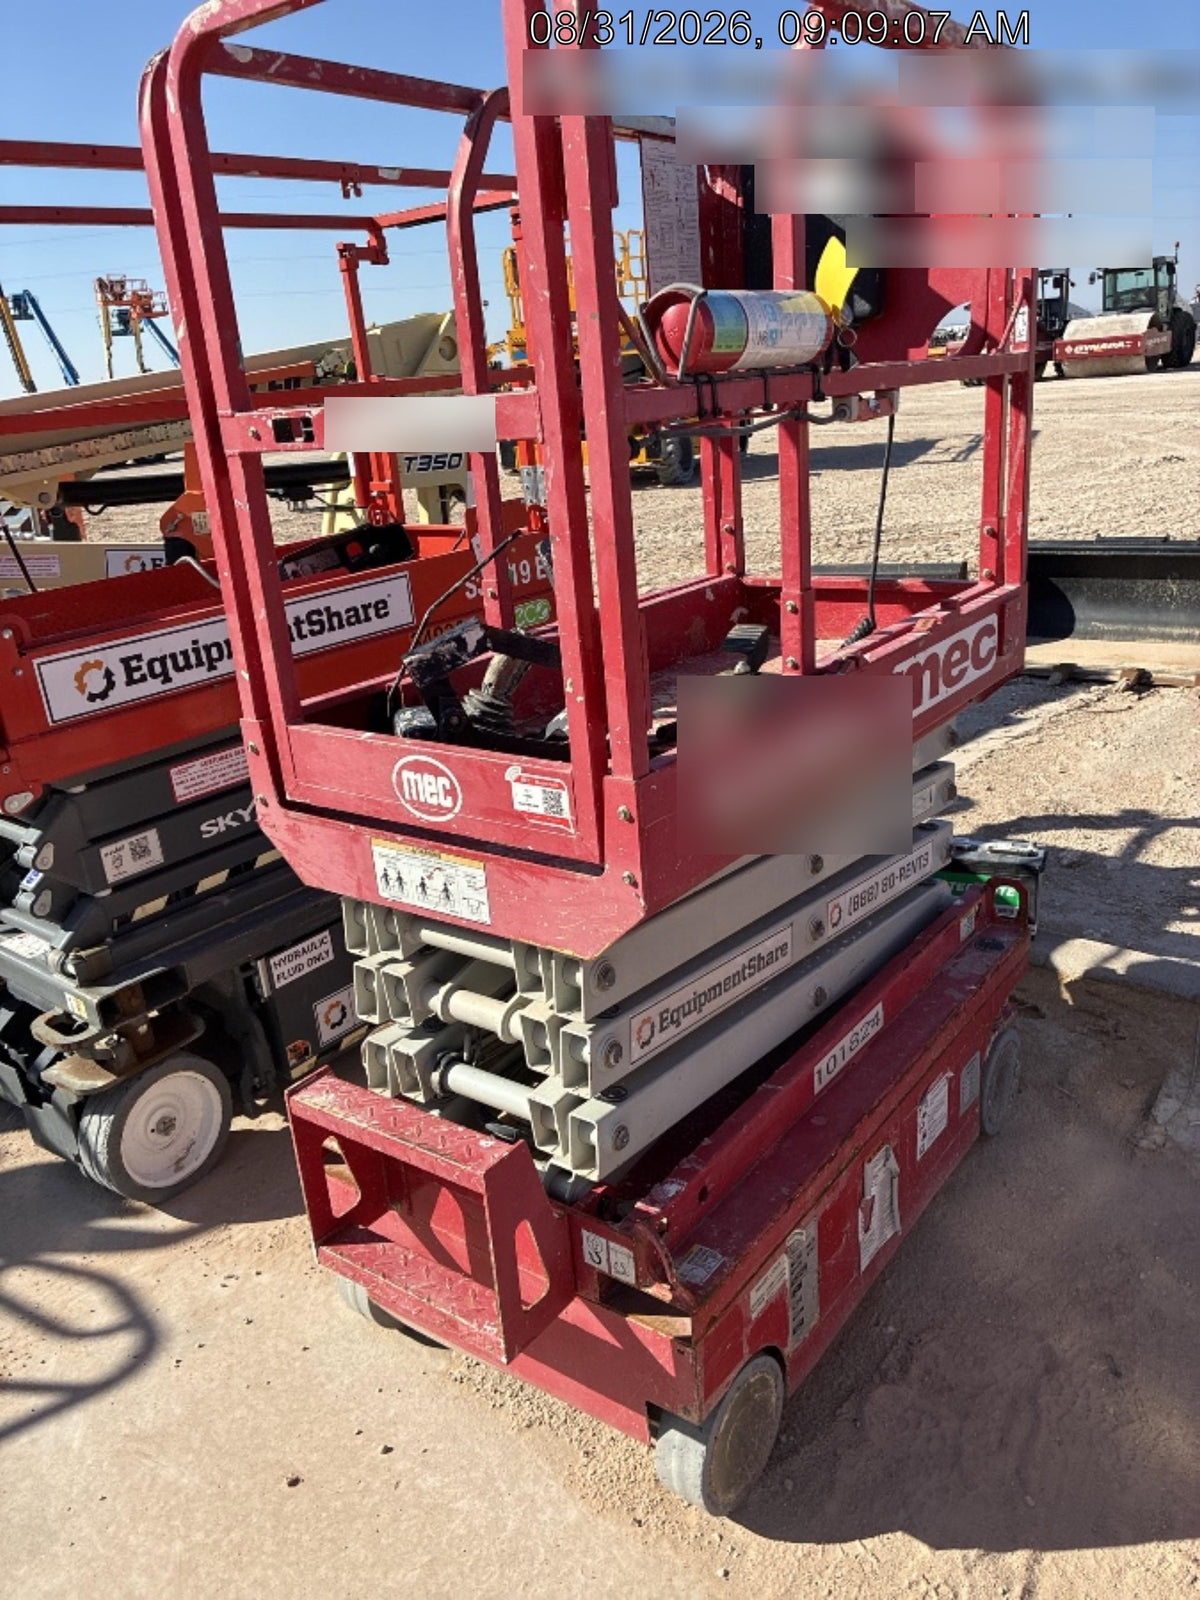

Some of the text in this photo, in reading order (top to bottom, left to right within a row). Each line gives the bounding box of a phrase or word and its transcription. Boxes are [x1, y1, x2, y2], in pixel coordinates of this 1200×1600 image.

[404, 453, 463, 473] T350
[120, 597, 390, 688] EquiptShare
[401, 769, 453, 808] mec
[848, 880, 880, 916] (888)
[273, 936, 328, 970] HYDRAULIC
[276, 949, 330, 982] FLUID ONLY
[658, 941, 789, 1034] EquipmentShare
[816, 1010, 881, 1086] 101824
